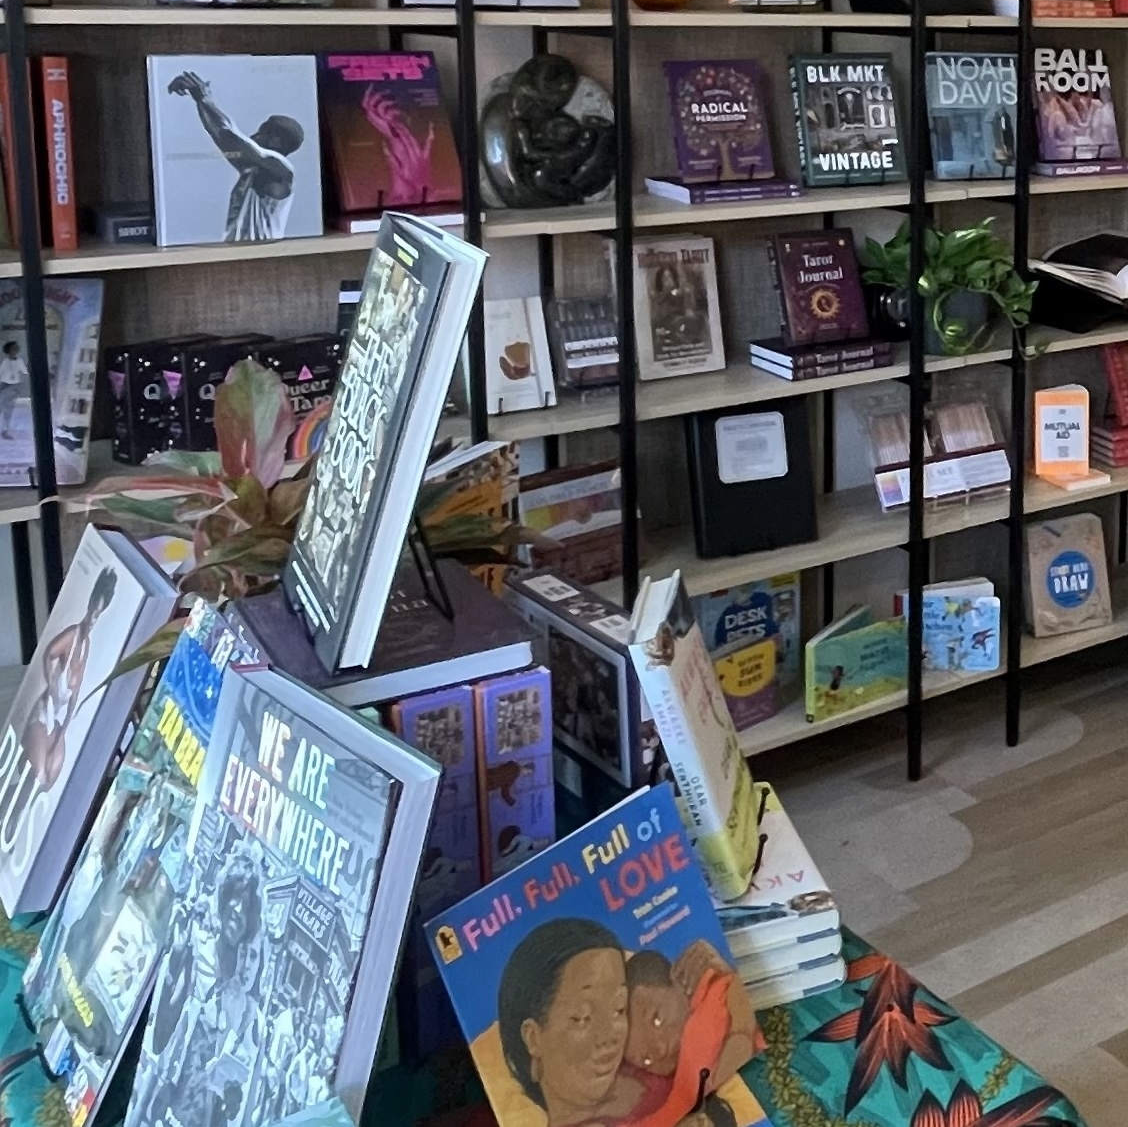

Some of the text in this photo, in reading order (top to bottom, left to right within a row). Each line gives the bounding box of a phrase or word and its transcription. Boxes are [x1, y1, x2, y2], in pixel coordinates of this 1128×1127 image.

[806, 65, 884, 83] BLK MKT
[936, 57, 1017, 81] NOAH
[938, 81, 1018, 105] DAVIS
[1035, 72, 1111, 93] ROOM
[691, 102, 748, 114] RADICAL
[694, 114, 747, 122] PERMISSION
[819, 151, 894, 171] VINTAGE
[803, 255, 834, 267] Tarot
[799, 266, 843, 283] Journal
[360, 327, 396, 397] THE
[340, 364, 388, 461] BLACK
[1044, 422, 1081, 431] MUTUAL
[1056, 431, 1071, 439] AID
[330, 416, 376, 504] BOOK
[1053, 572, 1088, 594] DRAW
[725, 607, 768, 630] DESK
[258, 710, 336, 811] WE ARE
[673, 761, 703, 828] SENTHURAN
[690, 772, 708, 808] DEAR
[219, 752, 350, 896] EVERYWHERE
[462, 807, 663, 952] Full, Full, Full of
[598, 833, 691, 912] LOVE
[296, 888, 335, 926] VILLAGE
[294, 903, 327, 940] CIGARS
